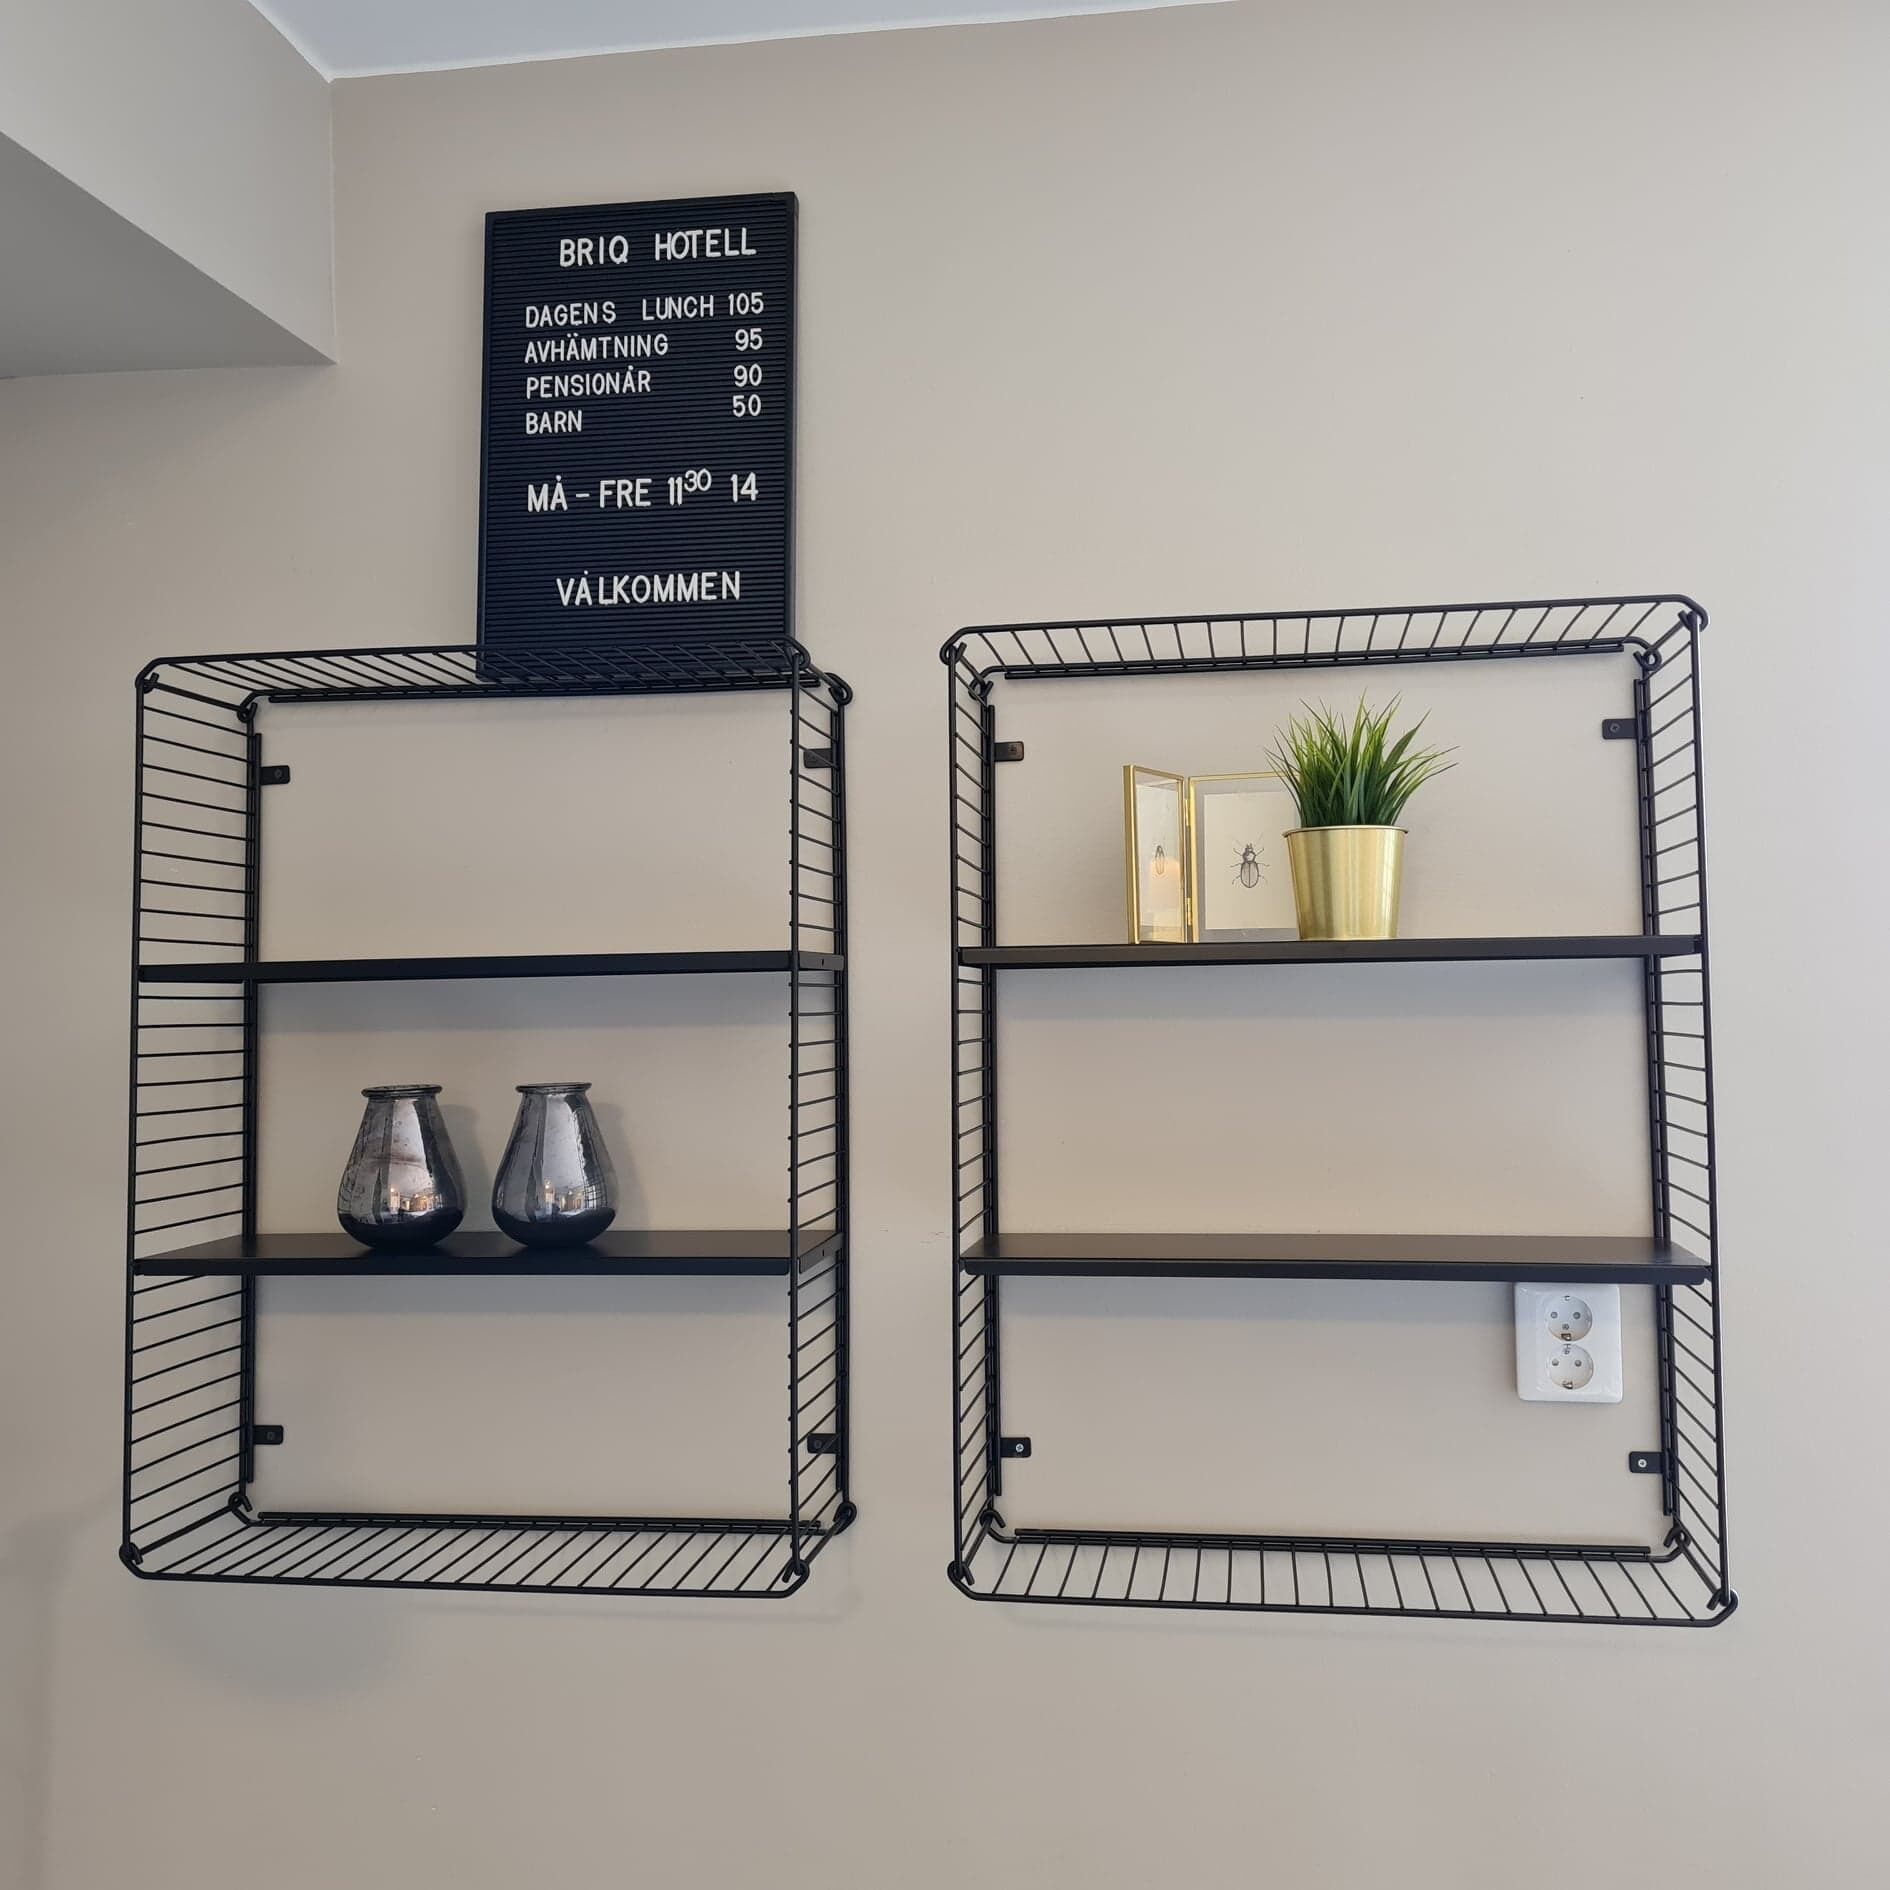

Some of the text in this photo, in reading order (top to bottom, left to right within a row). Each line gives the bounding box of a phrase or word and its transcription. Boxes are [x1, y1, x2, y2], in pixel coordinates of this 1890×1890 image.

[559, 227, 757, 268] BRIQ HOTELL
[525, 291, 764, 328] DAGENS LUNCH 105
[524, 328, 763, 364] AVHÄMTNING 95
[733, 363, 763, 387] 90
[525, 394, 762, 435] BARN 50
[527, 475, 568, 512] MÅ
[599, 478, 653, 509] FRE
[730, 471, 759, 503] 14
